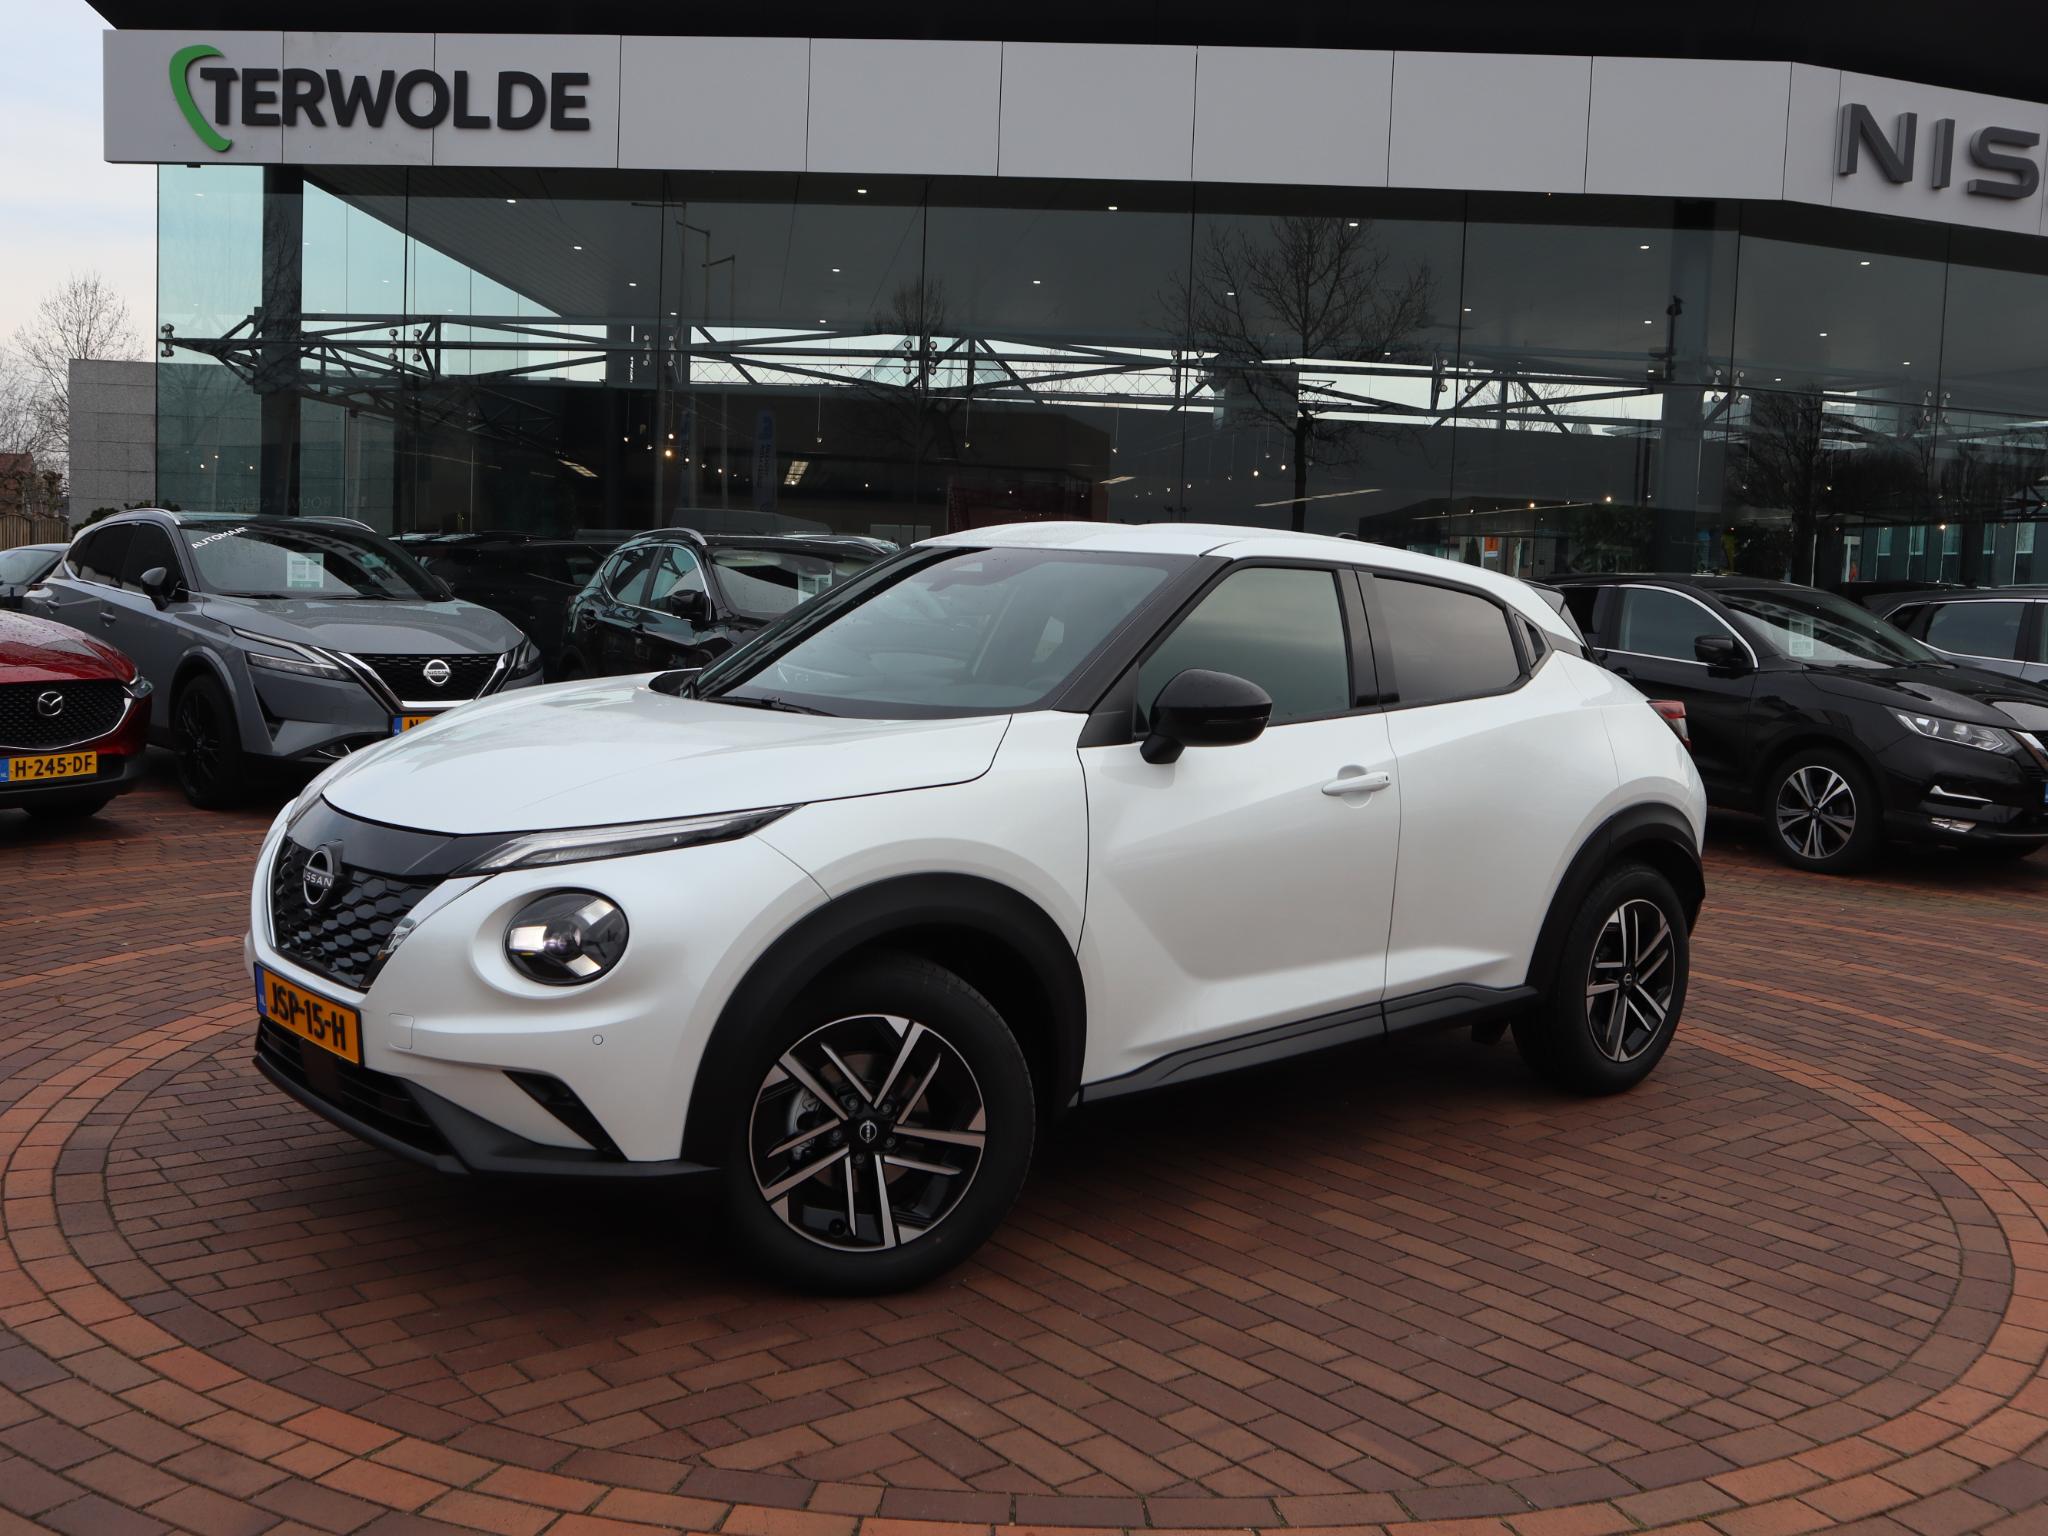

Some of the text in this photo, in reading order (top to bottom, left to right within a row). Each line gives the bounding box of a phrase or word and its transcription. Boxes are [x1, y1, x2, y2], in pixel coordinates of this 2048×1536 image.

[199, 66, 591, 131] TERWOLDE
[191, 526, 248, 549] AUTOMAAT
[15, 754, 93, 778] H-245-DF
[270, 982, 347, 1051] JSP-15-H
